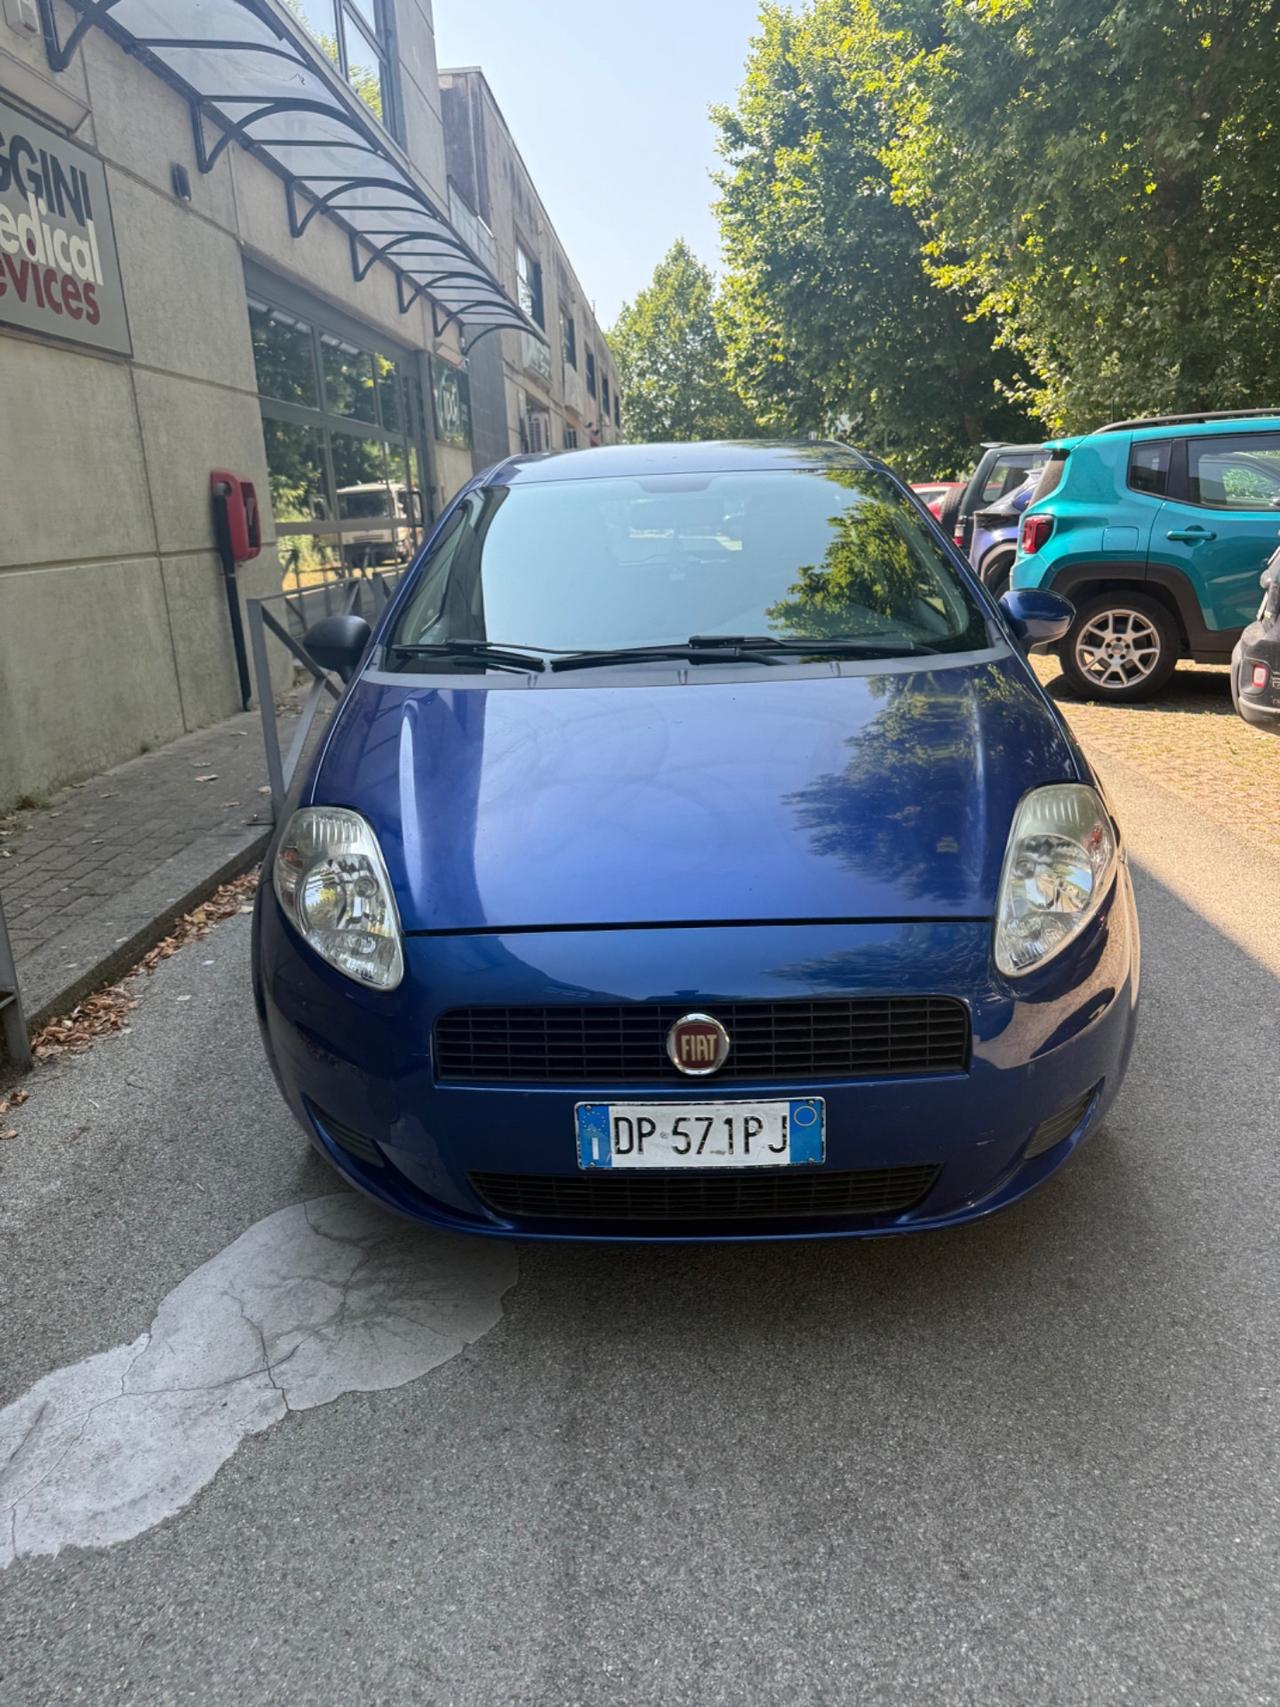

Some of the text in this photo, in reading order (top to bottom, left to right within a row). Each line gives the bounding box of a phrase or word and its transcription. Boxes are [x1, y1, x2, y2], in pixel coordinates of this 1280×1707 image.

[681, 1034, 718, 1062] FIAT
[614, 1116, 656, 1155] DP
[671, 1113, 788, 1155] 571PJ
